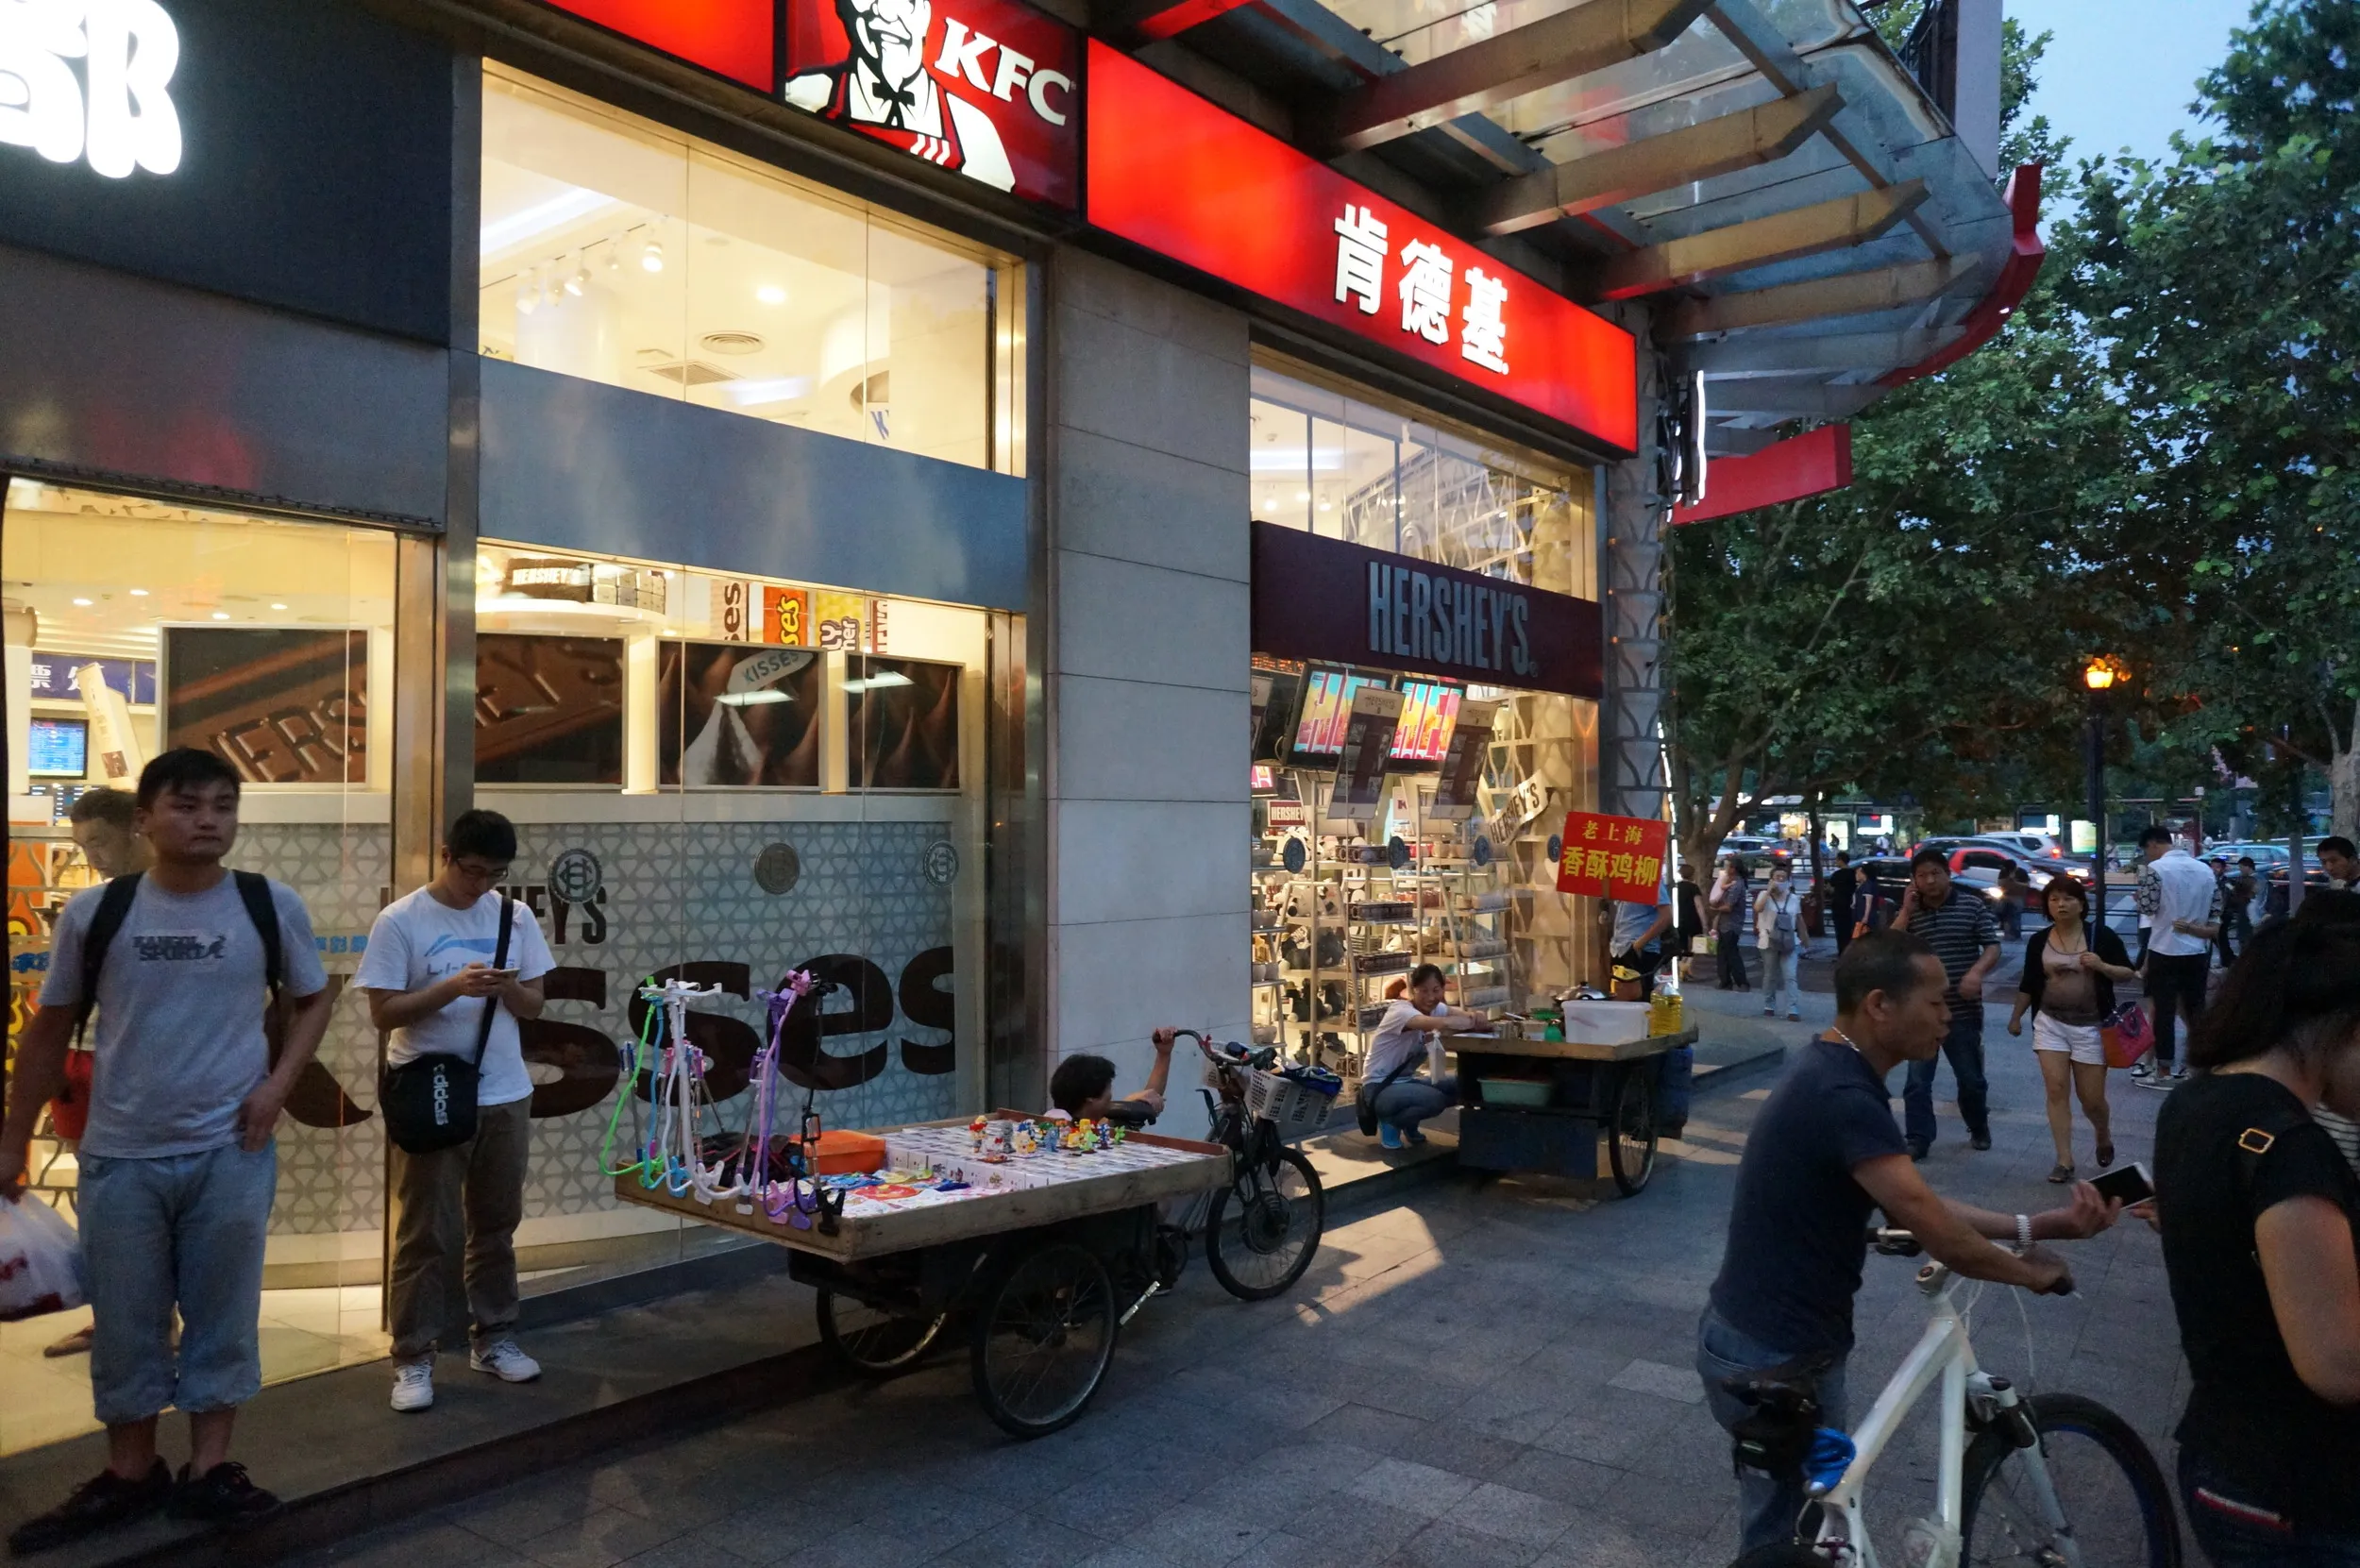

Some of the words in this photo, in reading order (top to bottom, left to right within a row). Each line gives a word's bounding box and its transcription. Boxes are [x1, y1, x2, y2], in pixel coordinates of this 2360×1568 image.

[934, 17, 1070, 126] KFC
[1334, 203, 1508, 374] 肯德基
[1370, 562, 1528, 675] HERSHEY'S
[744, 650, 800, 683] KISSES
[1582, 819, 1644, 846] 老上海
[1562, 846, 1660, 887] 香酥鸡柳
[433, 1063, 449, 1126] adidas
